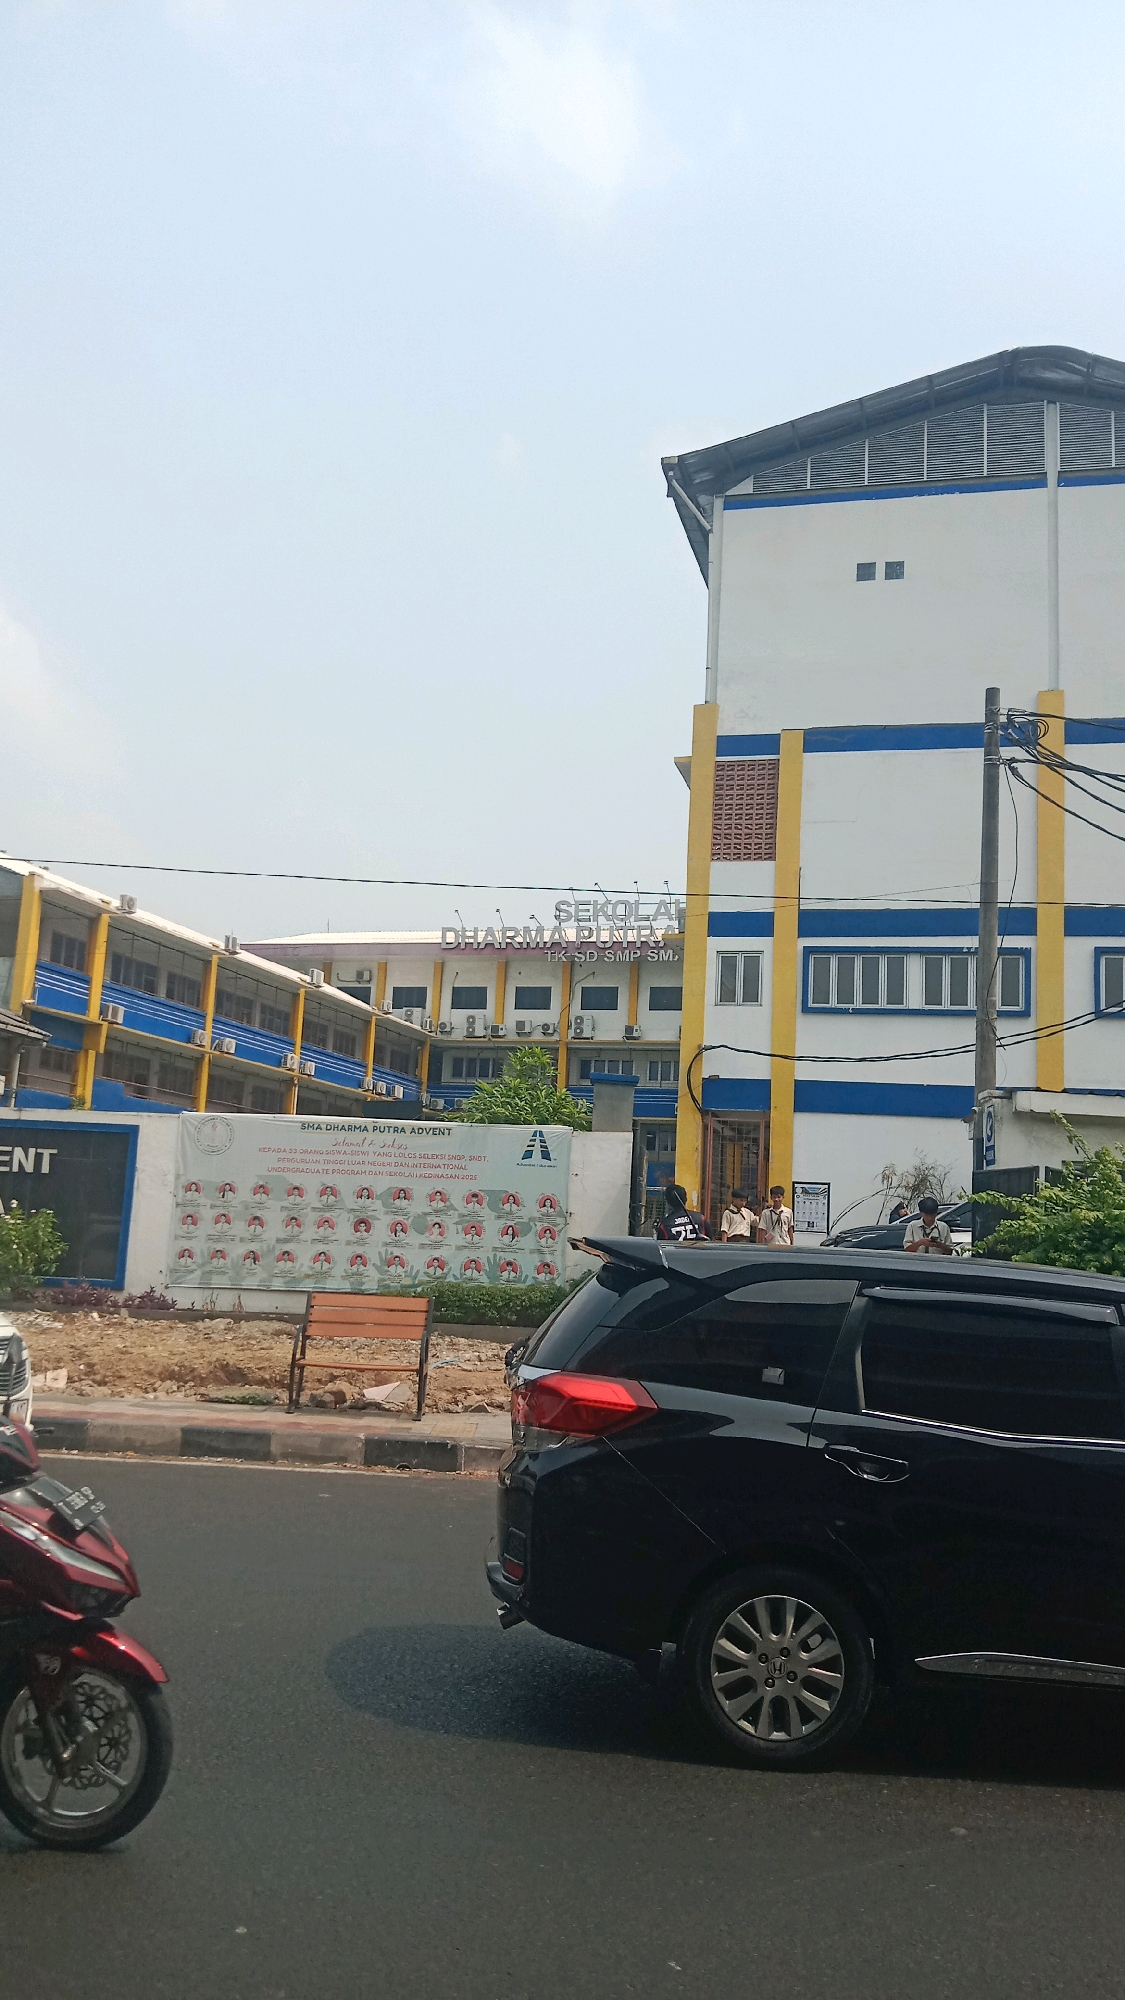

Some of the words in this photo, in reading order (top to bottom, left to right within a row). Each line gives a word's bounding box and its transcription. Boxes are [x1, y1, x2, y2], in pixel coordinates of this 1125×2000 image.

[441, 925, 568, 949] DHARMA
[574, 950, 598, 962] SD
[604, 950, 641, 962] SMP
[300, 1123, 322, 1131] SMA
[325, 1124, 369, 1133] DHARMA
[372, 1125, 406, 1134] PUTRA
[410, 1127, 452, 1136] ADVENT
[267, 1166, 330, 1175] UNDERGRADUATE
[410, 1162, 468, 1170] INTERNATIONAL
